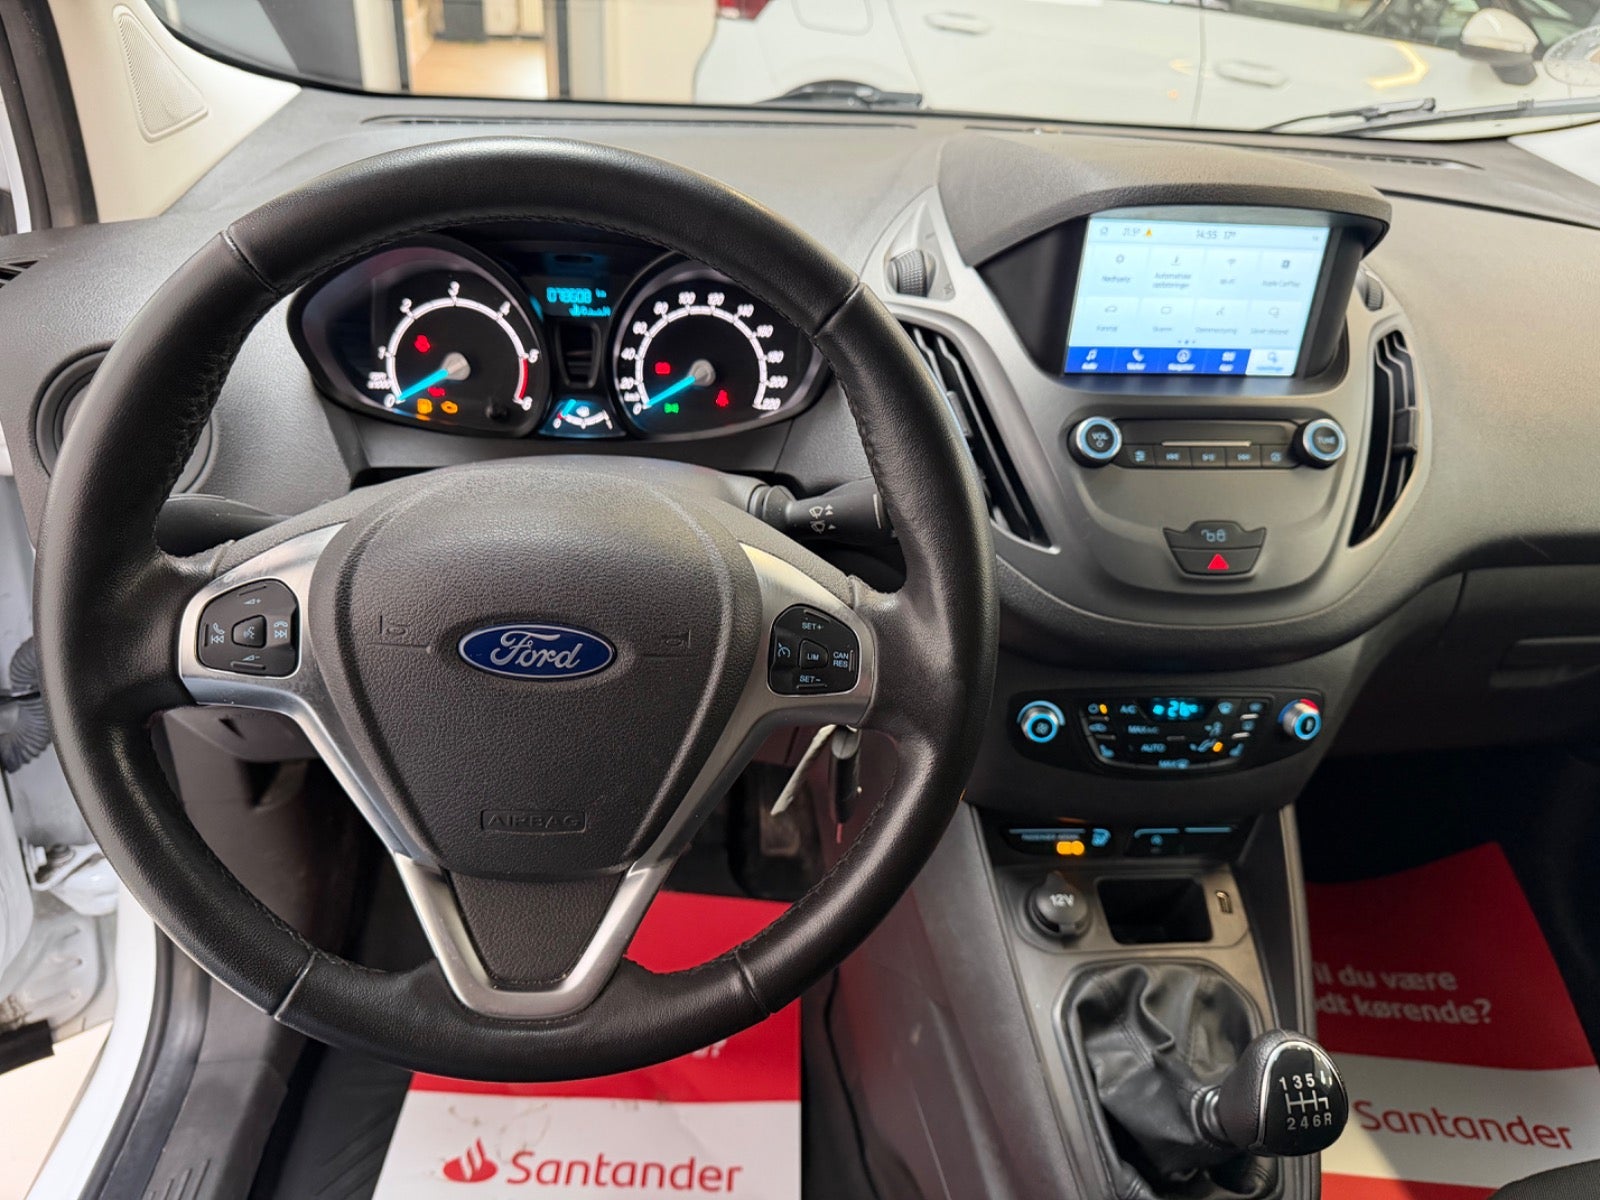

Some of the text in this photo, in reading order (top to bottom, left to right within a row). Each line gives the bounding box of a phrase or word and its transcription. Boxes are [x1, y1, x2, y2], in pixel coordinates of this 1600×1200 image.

[448, 281, 460, 297] 3
[400, 298, 412, 313] 2
[500, 301, 511, 316] 4
[383, 393, 396, 408] 0
[1091, 432, 1109, 440] VOL
[490, 631, 584, 669] Ford
[807, 653, 819, 661] LIM
[833, 651, 849, 660] CAN
[1141, 743, 1166, 753] AUTO
[488, 815, 580, 829] AIRBAG
[1050, 894, 1075, 907] 12V
[1338, 966, 1377, 989] du
[1379, 971, 1459, 992] være
[1352, 994, 1493, 1026] kørende?
[1279, 1072, 1316, 1091] 1 3 5
[1286, 1112, 1333, 1130] 2 4 6 R
[1352, 1099, 1573, 1150] Santander
[506, 1149, 744, 1194] Santander
